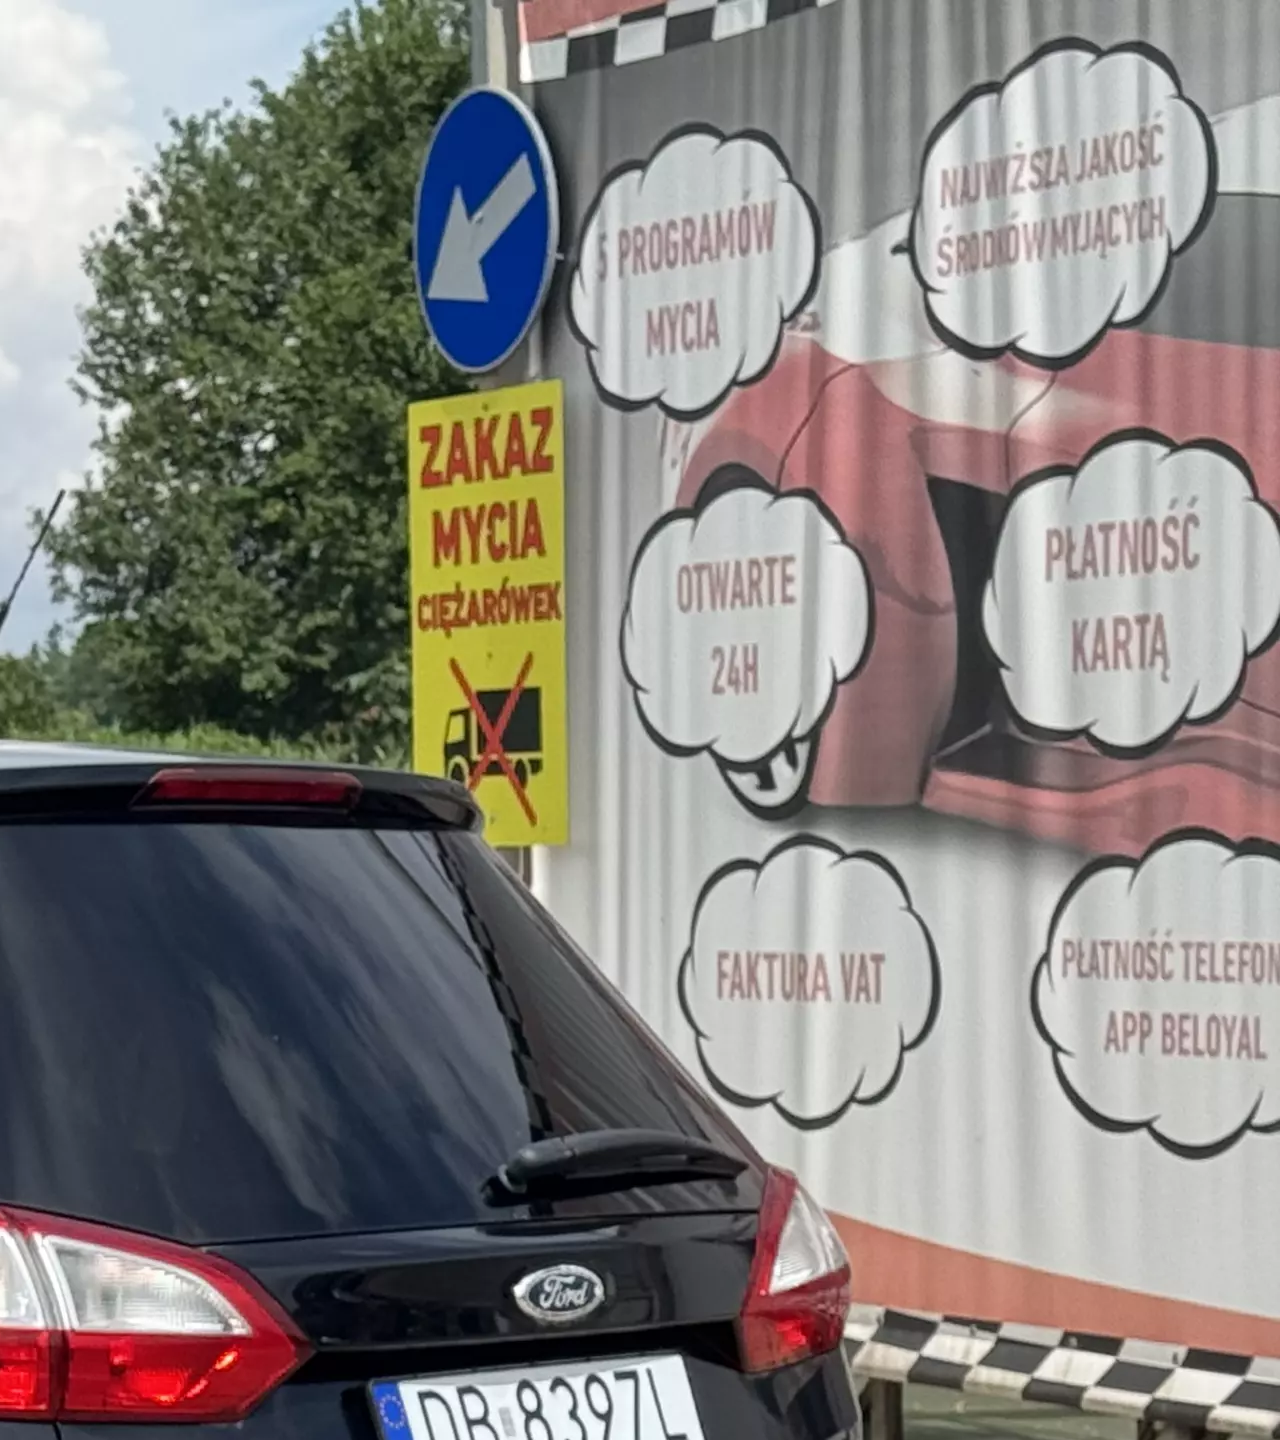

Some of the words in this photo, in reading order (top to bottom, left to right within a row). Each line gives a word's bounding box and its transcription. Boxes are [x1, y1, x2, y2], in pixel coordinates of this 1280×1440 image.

[940, 141, 1070, 209] NAJWYŻSZA
[1074, 110, 1165, 183] JAKOŚĆ
[618, 190, 777, 278] PROGRAMÓW
[936, 211, 1047, 277] ŚRODKÓW
[1050, 196, 1166, 259] MYJĄCYCH
[646, 298, 721, 358] MYCIA
[420, 406, 555, 489] ZAKAZ
[432, 497, 547, 569] MYCIA
[1045, 495, 1201, 582] PŁATNOŚĆ
[417, 576, 563, 639] CIĘŻARÓWEK
[677, 553, 797, 614] OTWARTE
[711, 643, 759, 695] 24H
[1072, 612, 1171, 684] KARTĄ
[717, 950, 832, 1003] FAKTURA
[839, 953, 886, 1004] VAT
[1061, 927, 1175, 982] PŁATNOŚĆ
[1103, 1010, 1153, 1055] APP
[1160, 1011, 1268, 1061] BELOYAL
[539, 1275, 588, 1309] Ford
